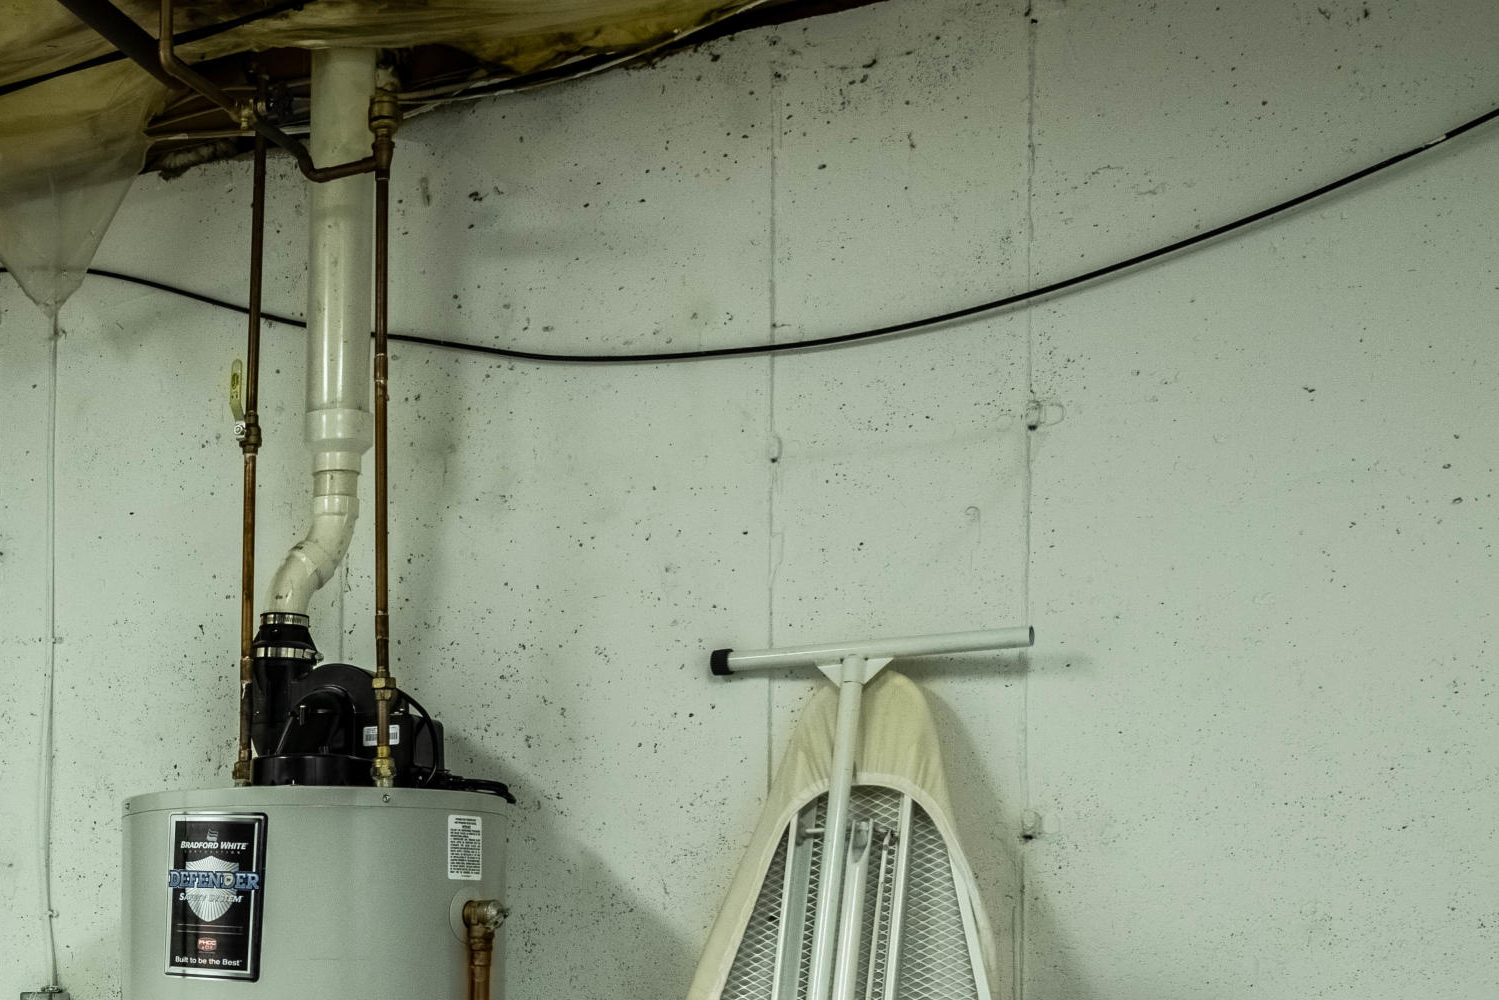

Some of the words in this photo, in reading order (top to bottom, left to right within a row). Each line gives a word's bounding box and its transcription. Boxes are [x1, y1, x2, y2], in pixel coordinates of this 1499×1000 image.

[180, 841, 219, 849] BRADFORD
[220, 842, 248, 850] WHITE
[169, 870, 260, 890] DEFENDER
